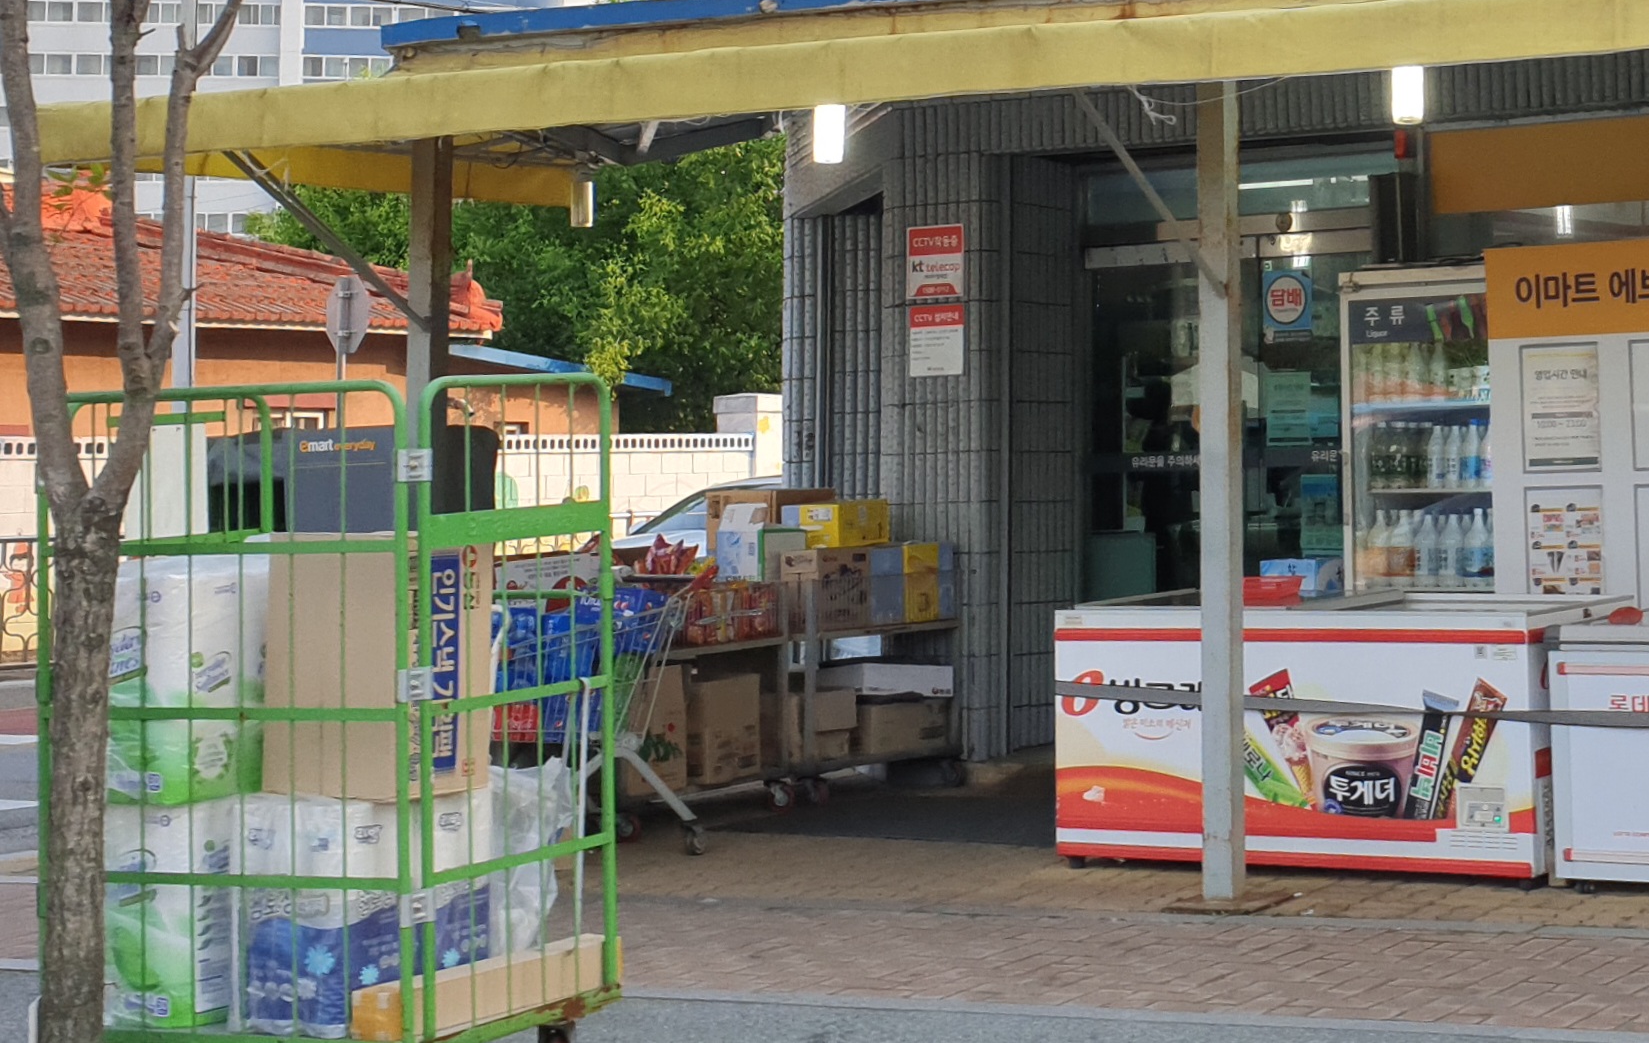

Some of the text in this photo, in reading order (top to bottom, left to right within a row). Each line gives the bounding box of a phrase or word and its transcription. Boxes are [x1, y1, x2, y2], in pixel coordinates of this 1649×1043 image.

[911, 259, 961, 274] kt telecop
[1270, 288, 1303, 307] 담배
[1514, 270, 1600, 309] 이마트
[1534, 368, 1588, 380] 영업시간 안내
[299, 438, 334, 453] emart
[431, 567, 457, 673] 인기스낵
[1328, 775, 1396, 805] 투게더
